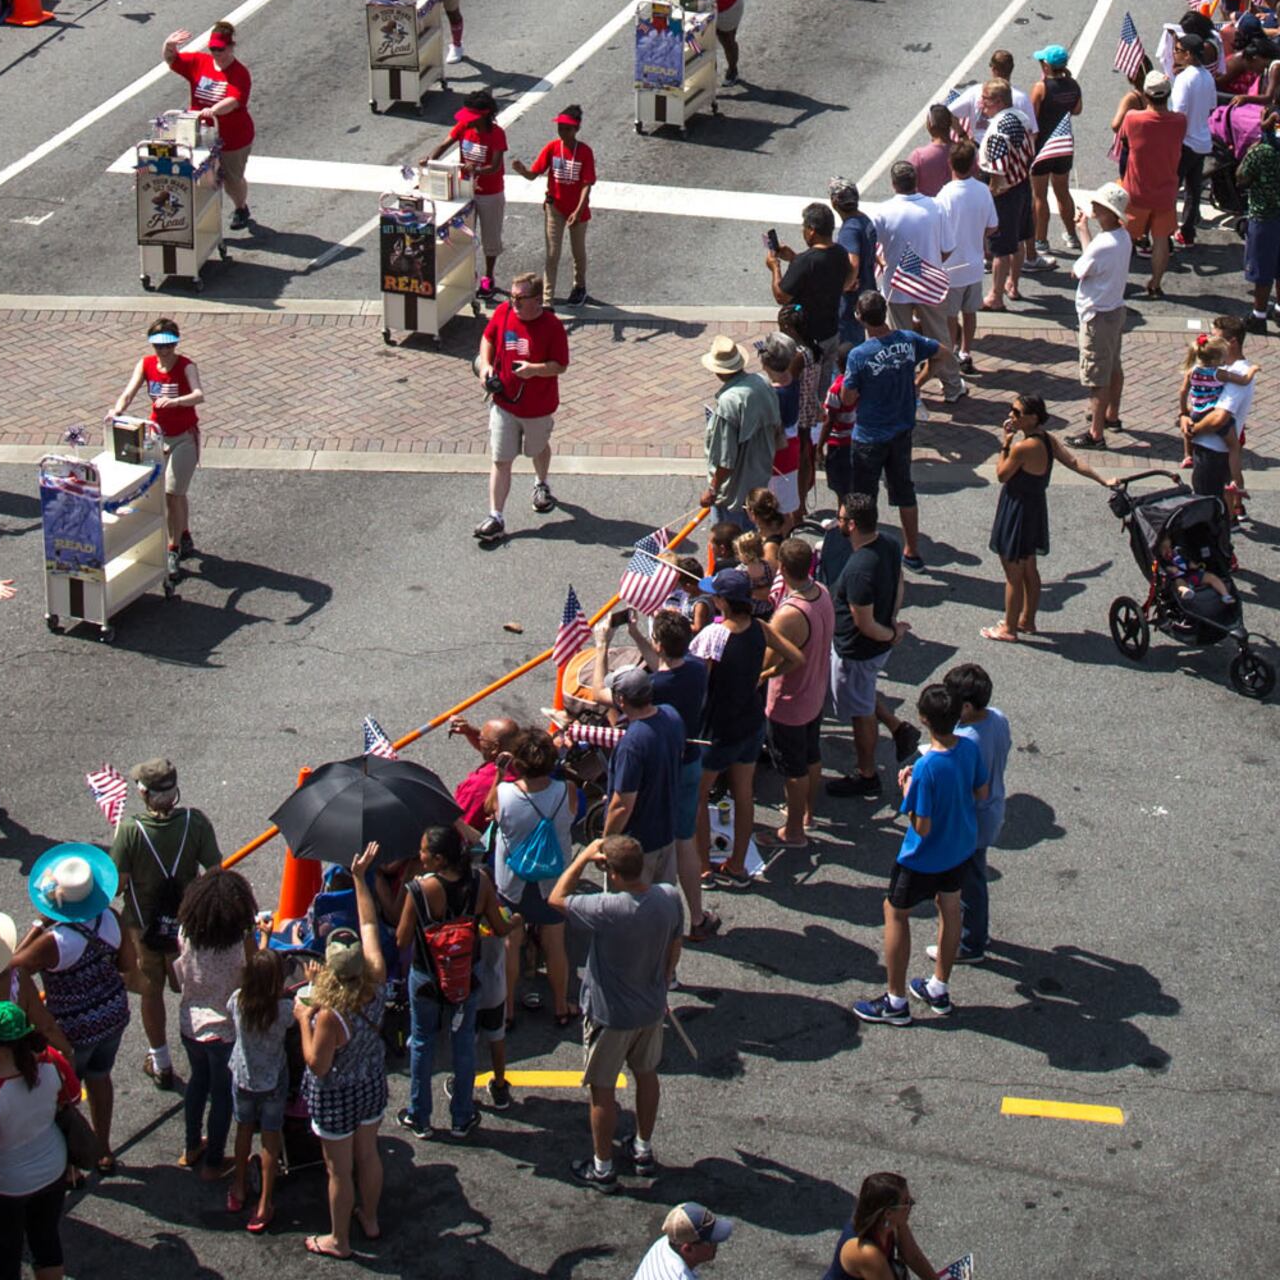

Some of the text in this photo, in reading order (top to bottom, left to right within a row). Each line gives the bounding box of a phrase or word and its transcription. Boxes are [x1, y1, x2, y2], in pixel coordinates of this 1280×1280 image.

[378, 41, 410, 55] Read
[147, 214, 185, 229] Read
[384, 275, 433, 296] READ
[868, 342, 915, 376] AFFLICTION
